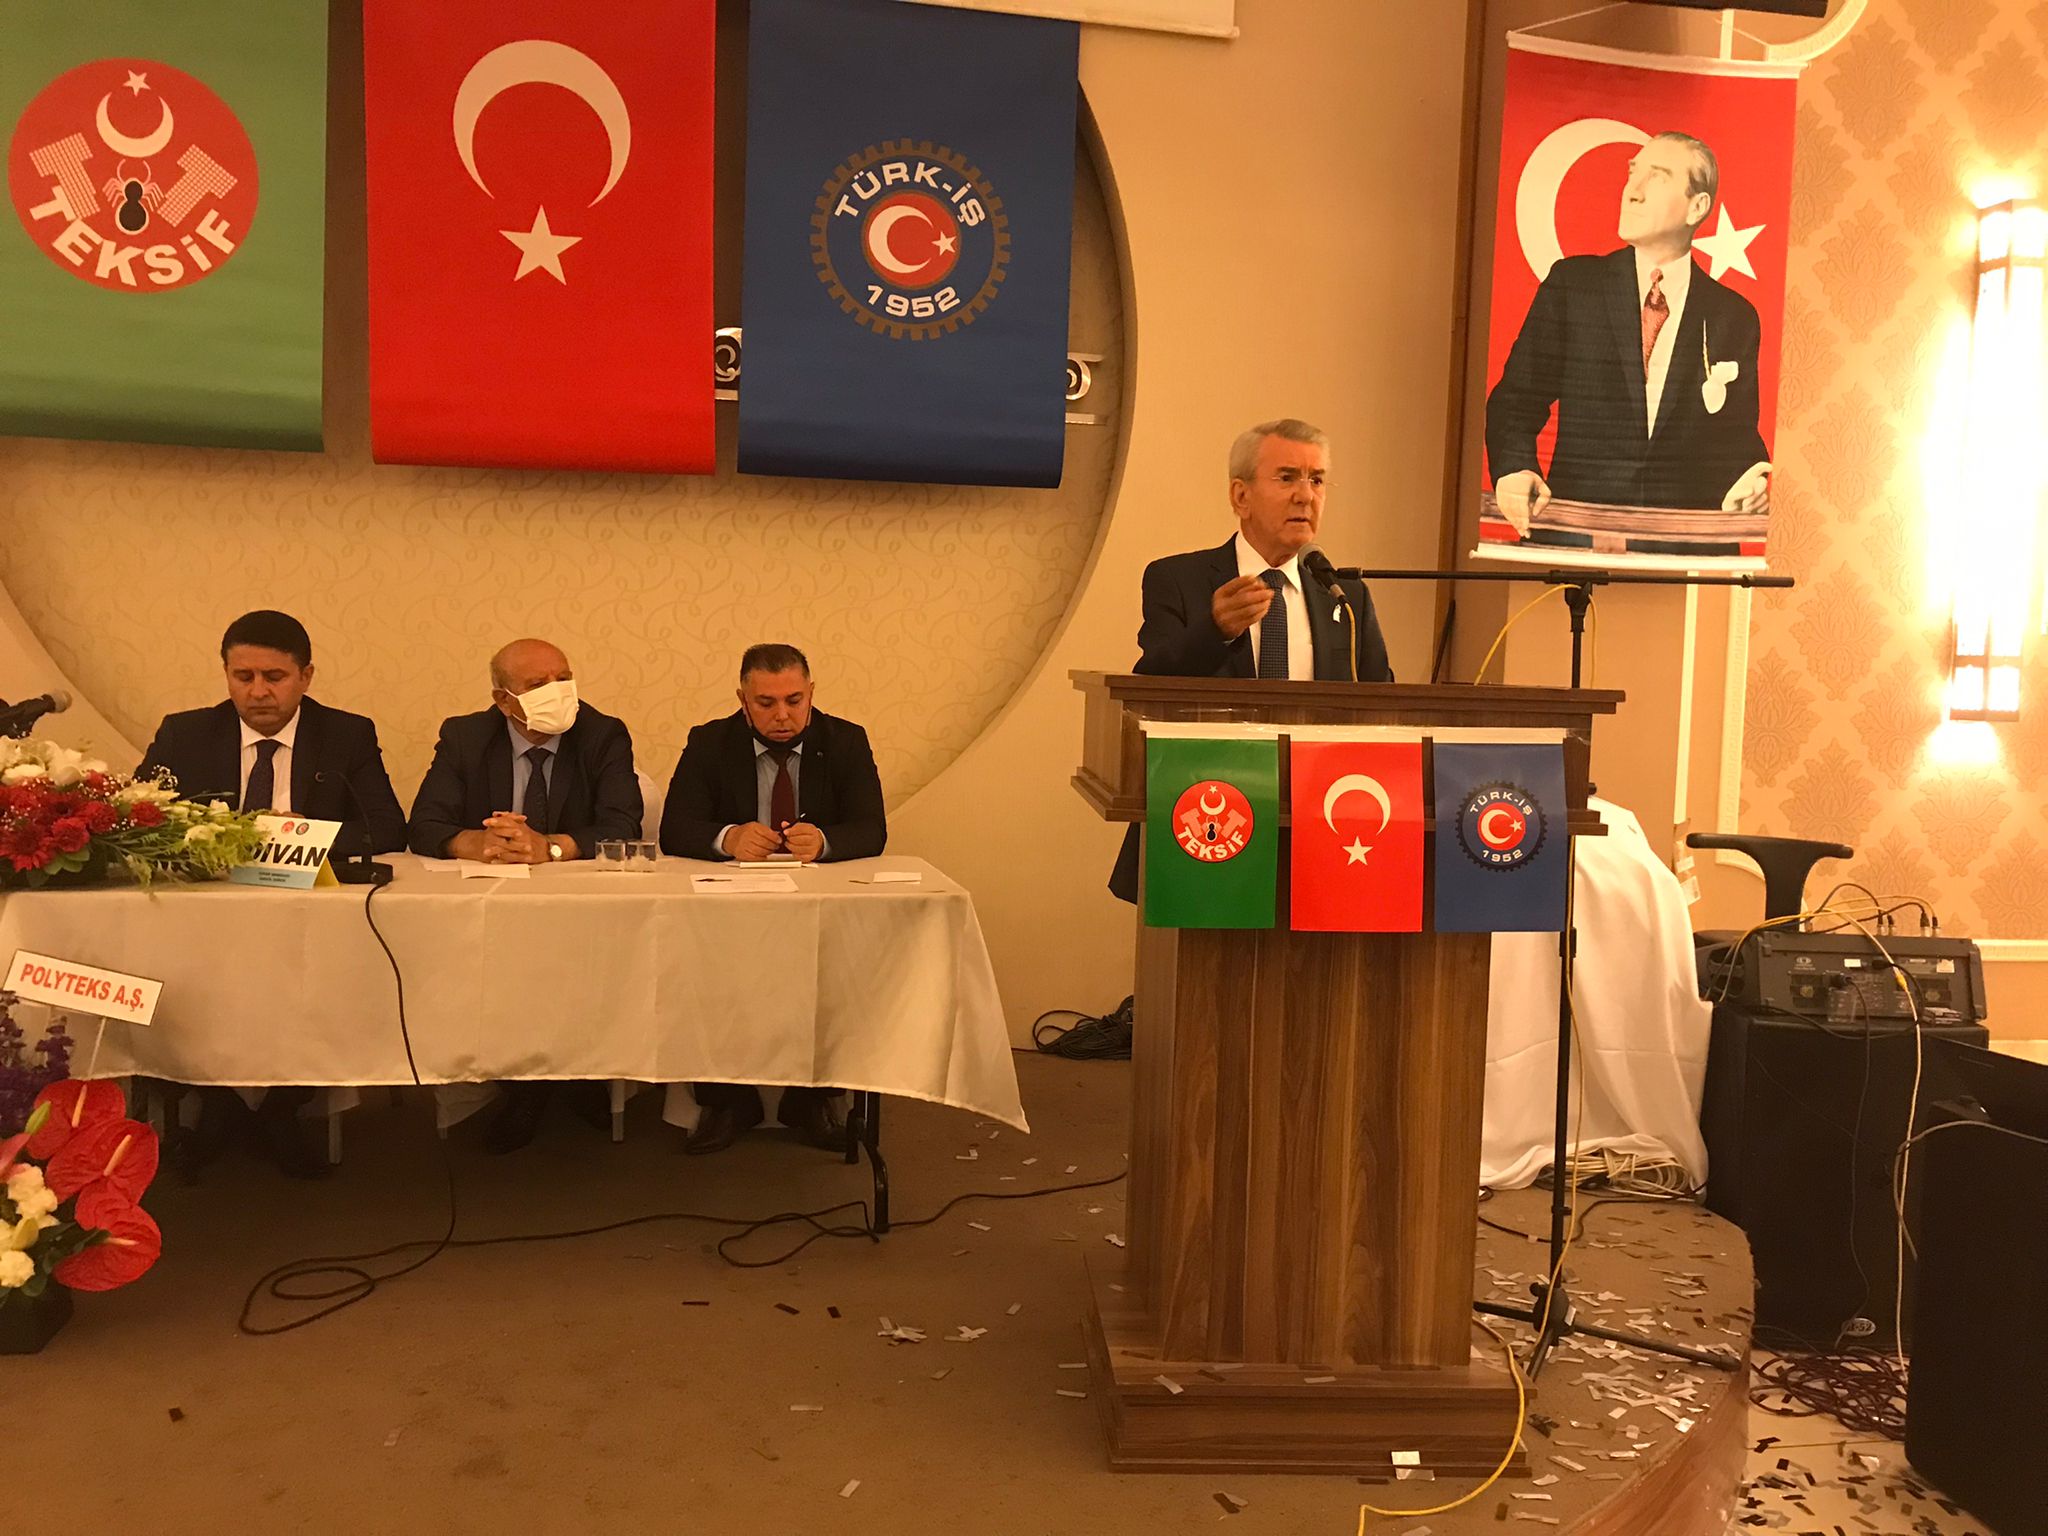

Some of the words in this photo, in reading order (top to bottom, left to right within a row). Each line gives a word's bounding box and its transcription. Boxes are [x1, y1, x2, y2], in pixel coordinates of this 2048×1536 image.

[834, 161, 986, 227] TÜRK-İŞ
[867, 285, 961, 318] 1952
[1482, 849, 1523, 862] 1952
[20, 963, 112, 1001] POLYTEKS
[112, 985, 144, 1012] A.Ş.
